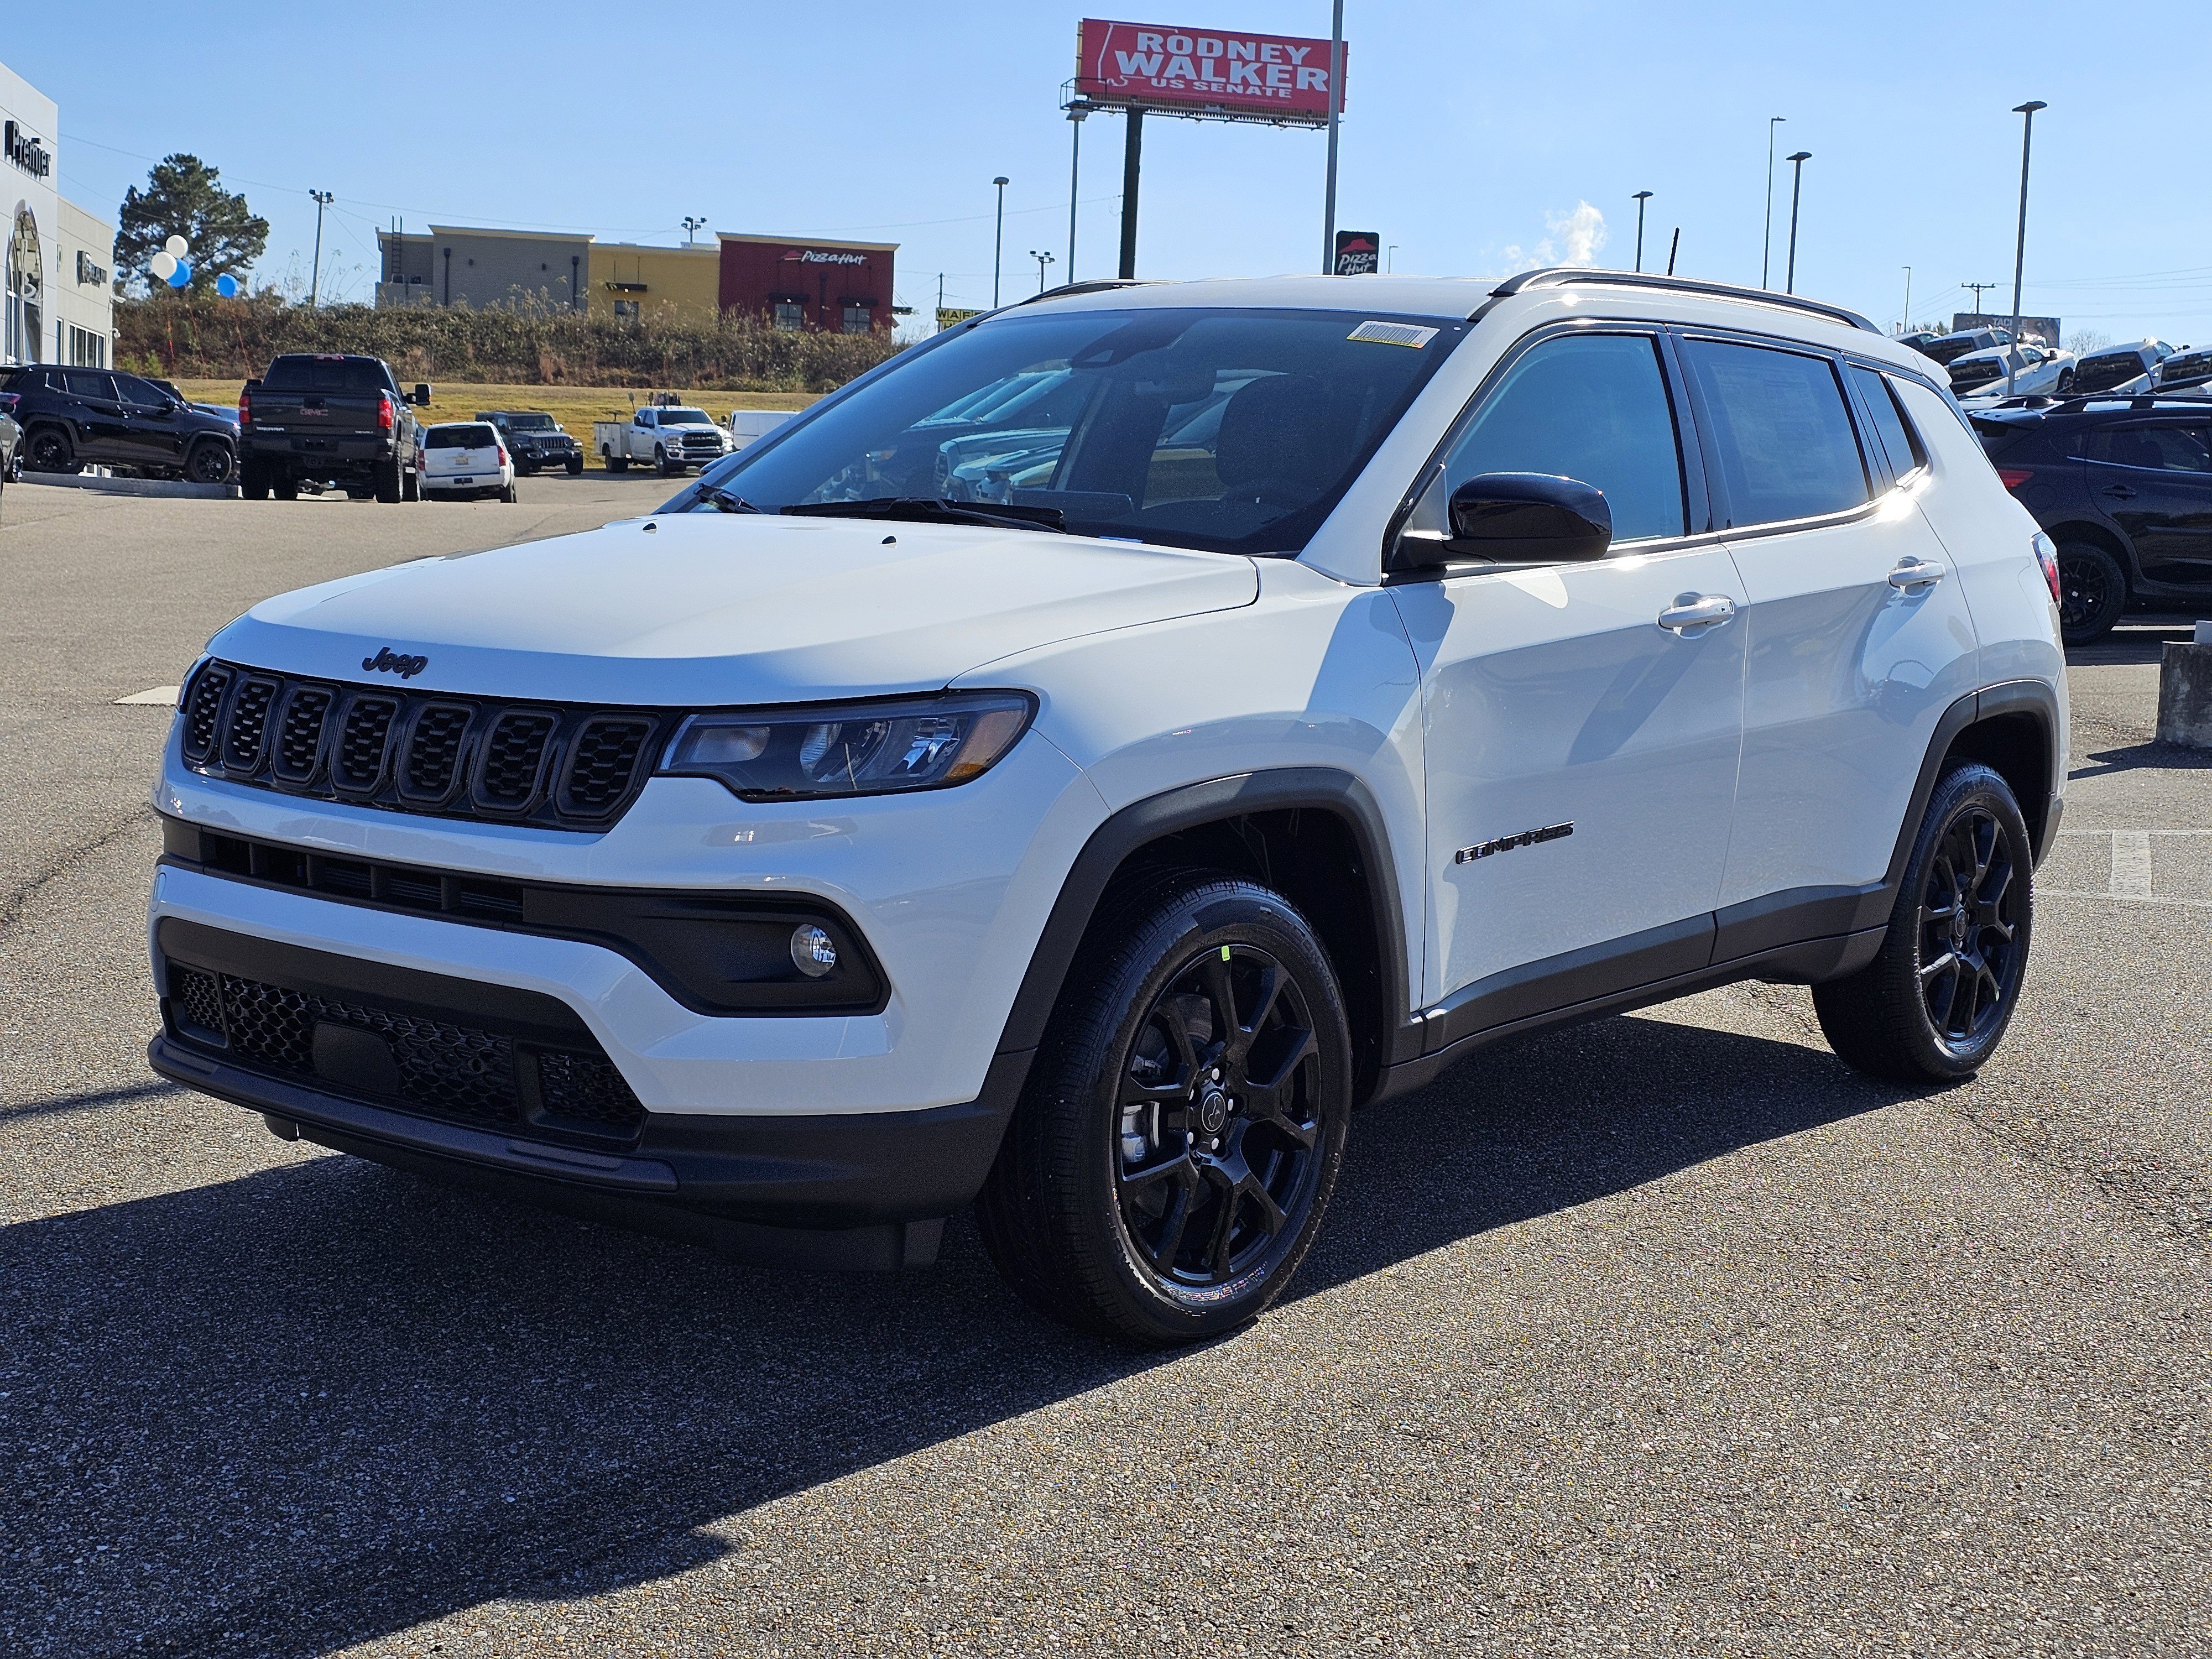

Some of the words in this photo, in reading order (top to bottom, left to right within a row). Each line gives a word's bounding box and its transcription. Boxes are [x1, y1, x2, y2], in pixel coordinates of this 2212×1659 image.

[1137, 32, 1311, 65] RODNEY
[1114, 50, 1328, 92] WALKER
[1151, 78, 1185, 90] US
[1192, 79, 1292, 98] SENATE
[5, 120, 51, 177] Premier
[801, 251, 838, 263] Pizza
[838, 253, 868, 265] Hut
[1338, 253, 1376, 272] Pizza
[1344, 262, 1373, 276] Hut
[937, 310, 982, 319] WAF
[362, 646, 429, 680] Jeep
[1455, 821, 1575, 864] COMPASS
